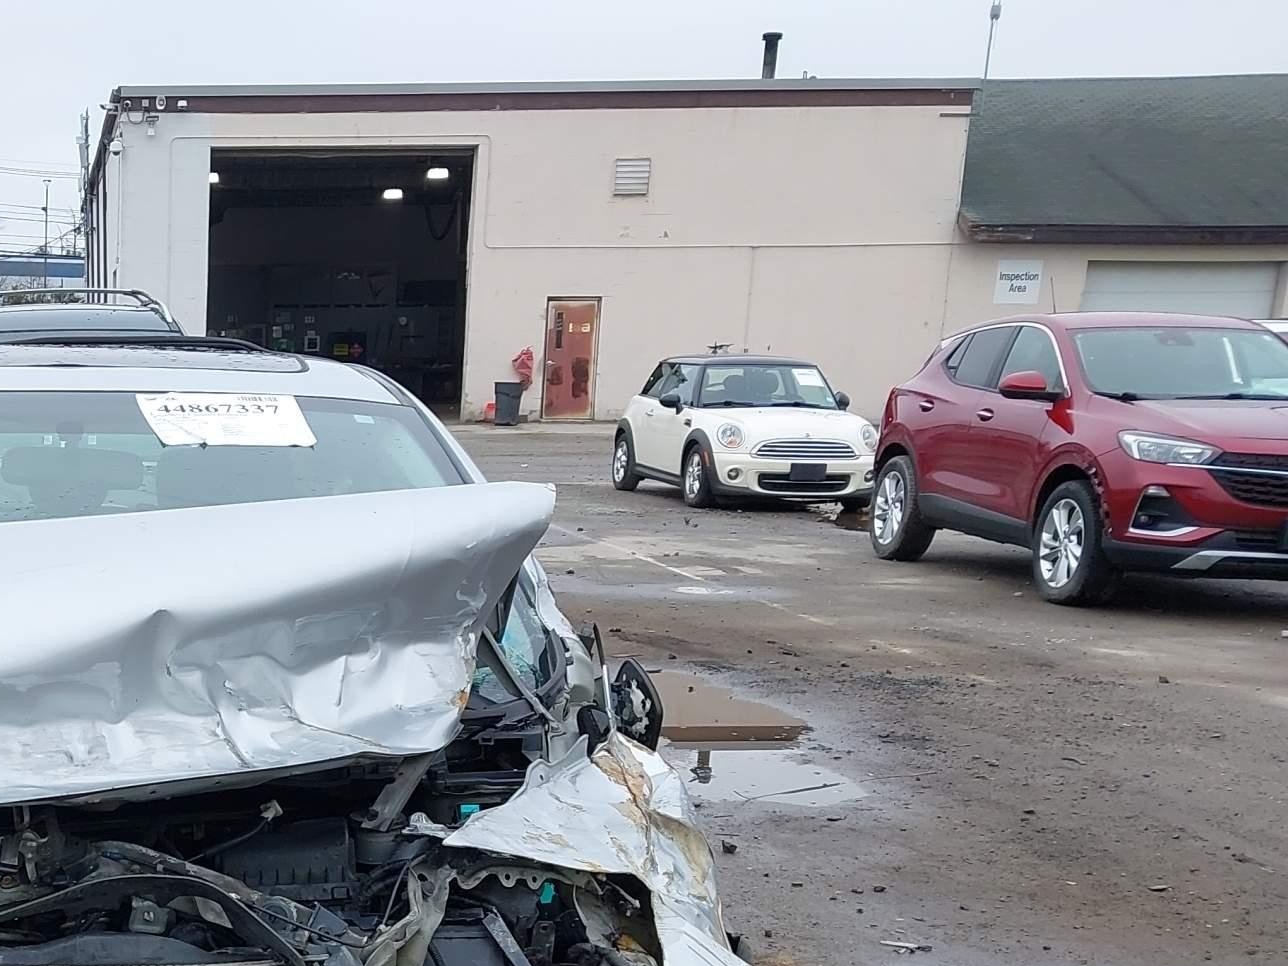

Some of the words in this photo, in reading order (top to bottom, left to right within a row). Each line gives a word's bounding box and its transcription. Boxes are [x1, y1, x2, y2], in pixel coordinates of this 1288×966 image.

[999, 271, 1039, 283] Inspection
[1008, 283, 1027, 292] Area
[157, 404, 279, 415] 44867337
